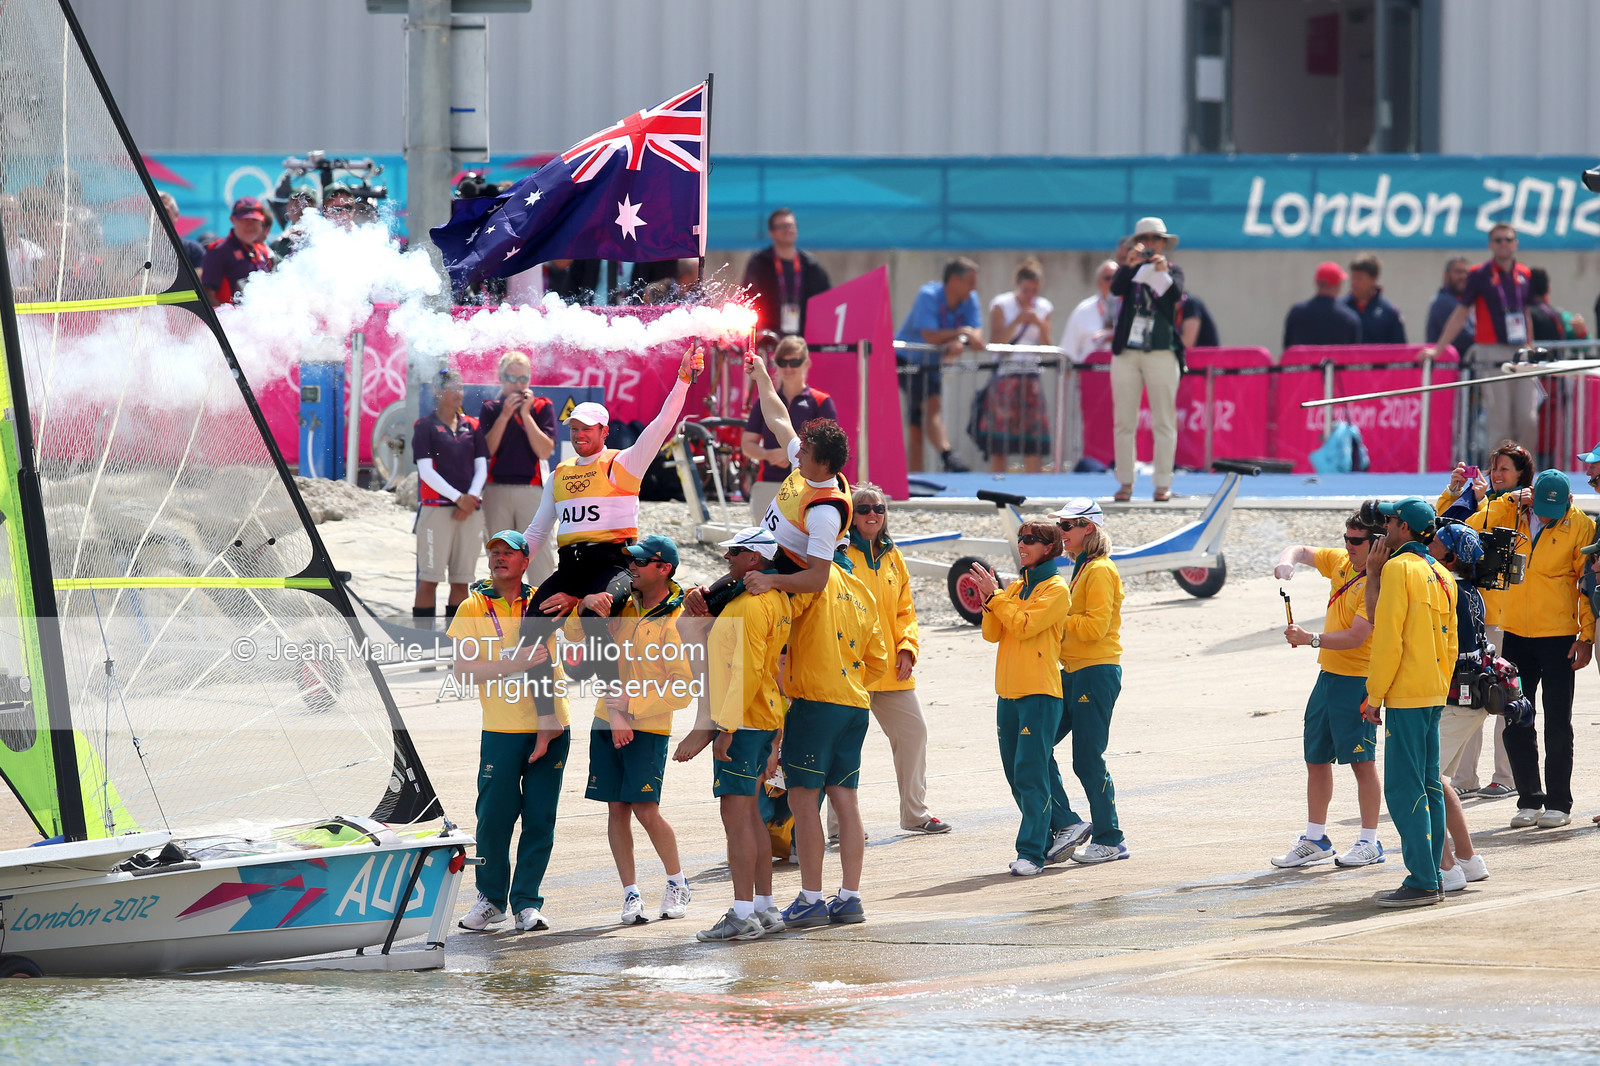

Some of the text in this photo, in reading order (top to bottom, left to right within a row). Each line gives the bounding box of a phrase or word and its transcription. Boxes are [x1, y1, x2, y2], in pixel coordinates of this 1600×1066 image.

[1243, 174, 1462, 237] London
[834, 303, 847, 343] 1
[562, 473, 583, 481] London
[561, 505, 600, 524] AUS
[334, 851, 434, 917] AUS
[10, 895, 160, 931] London 2012
